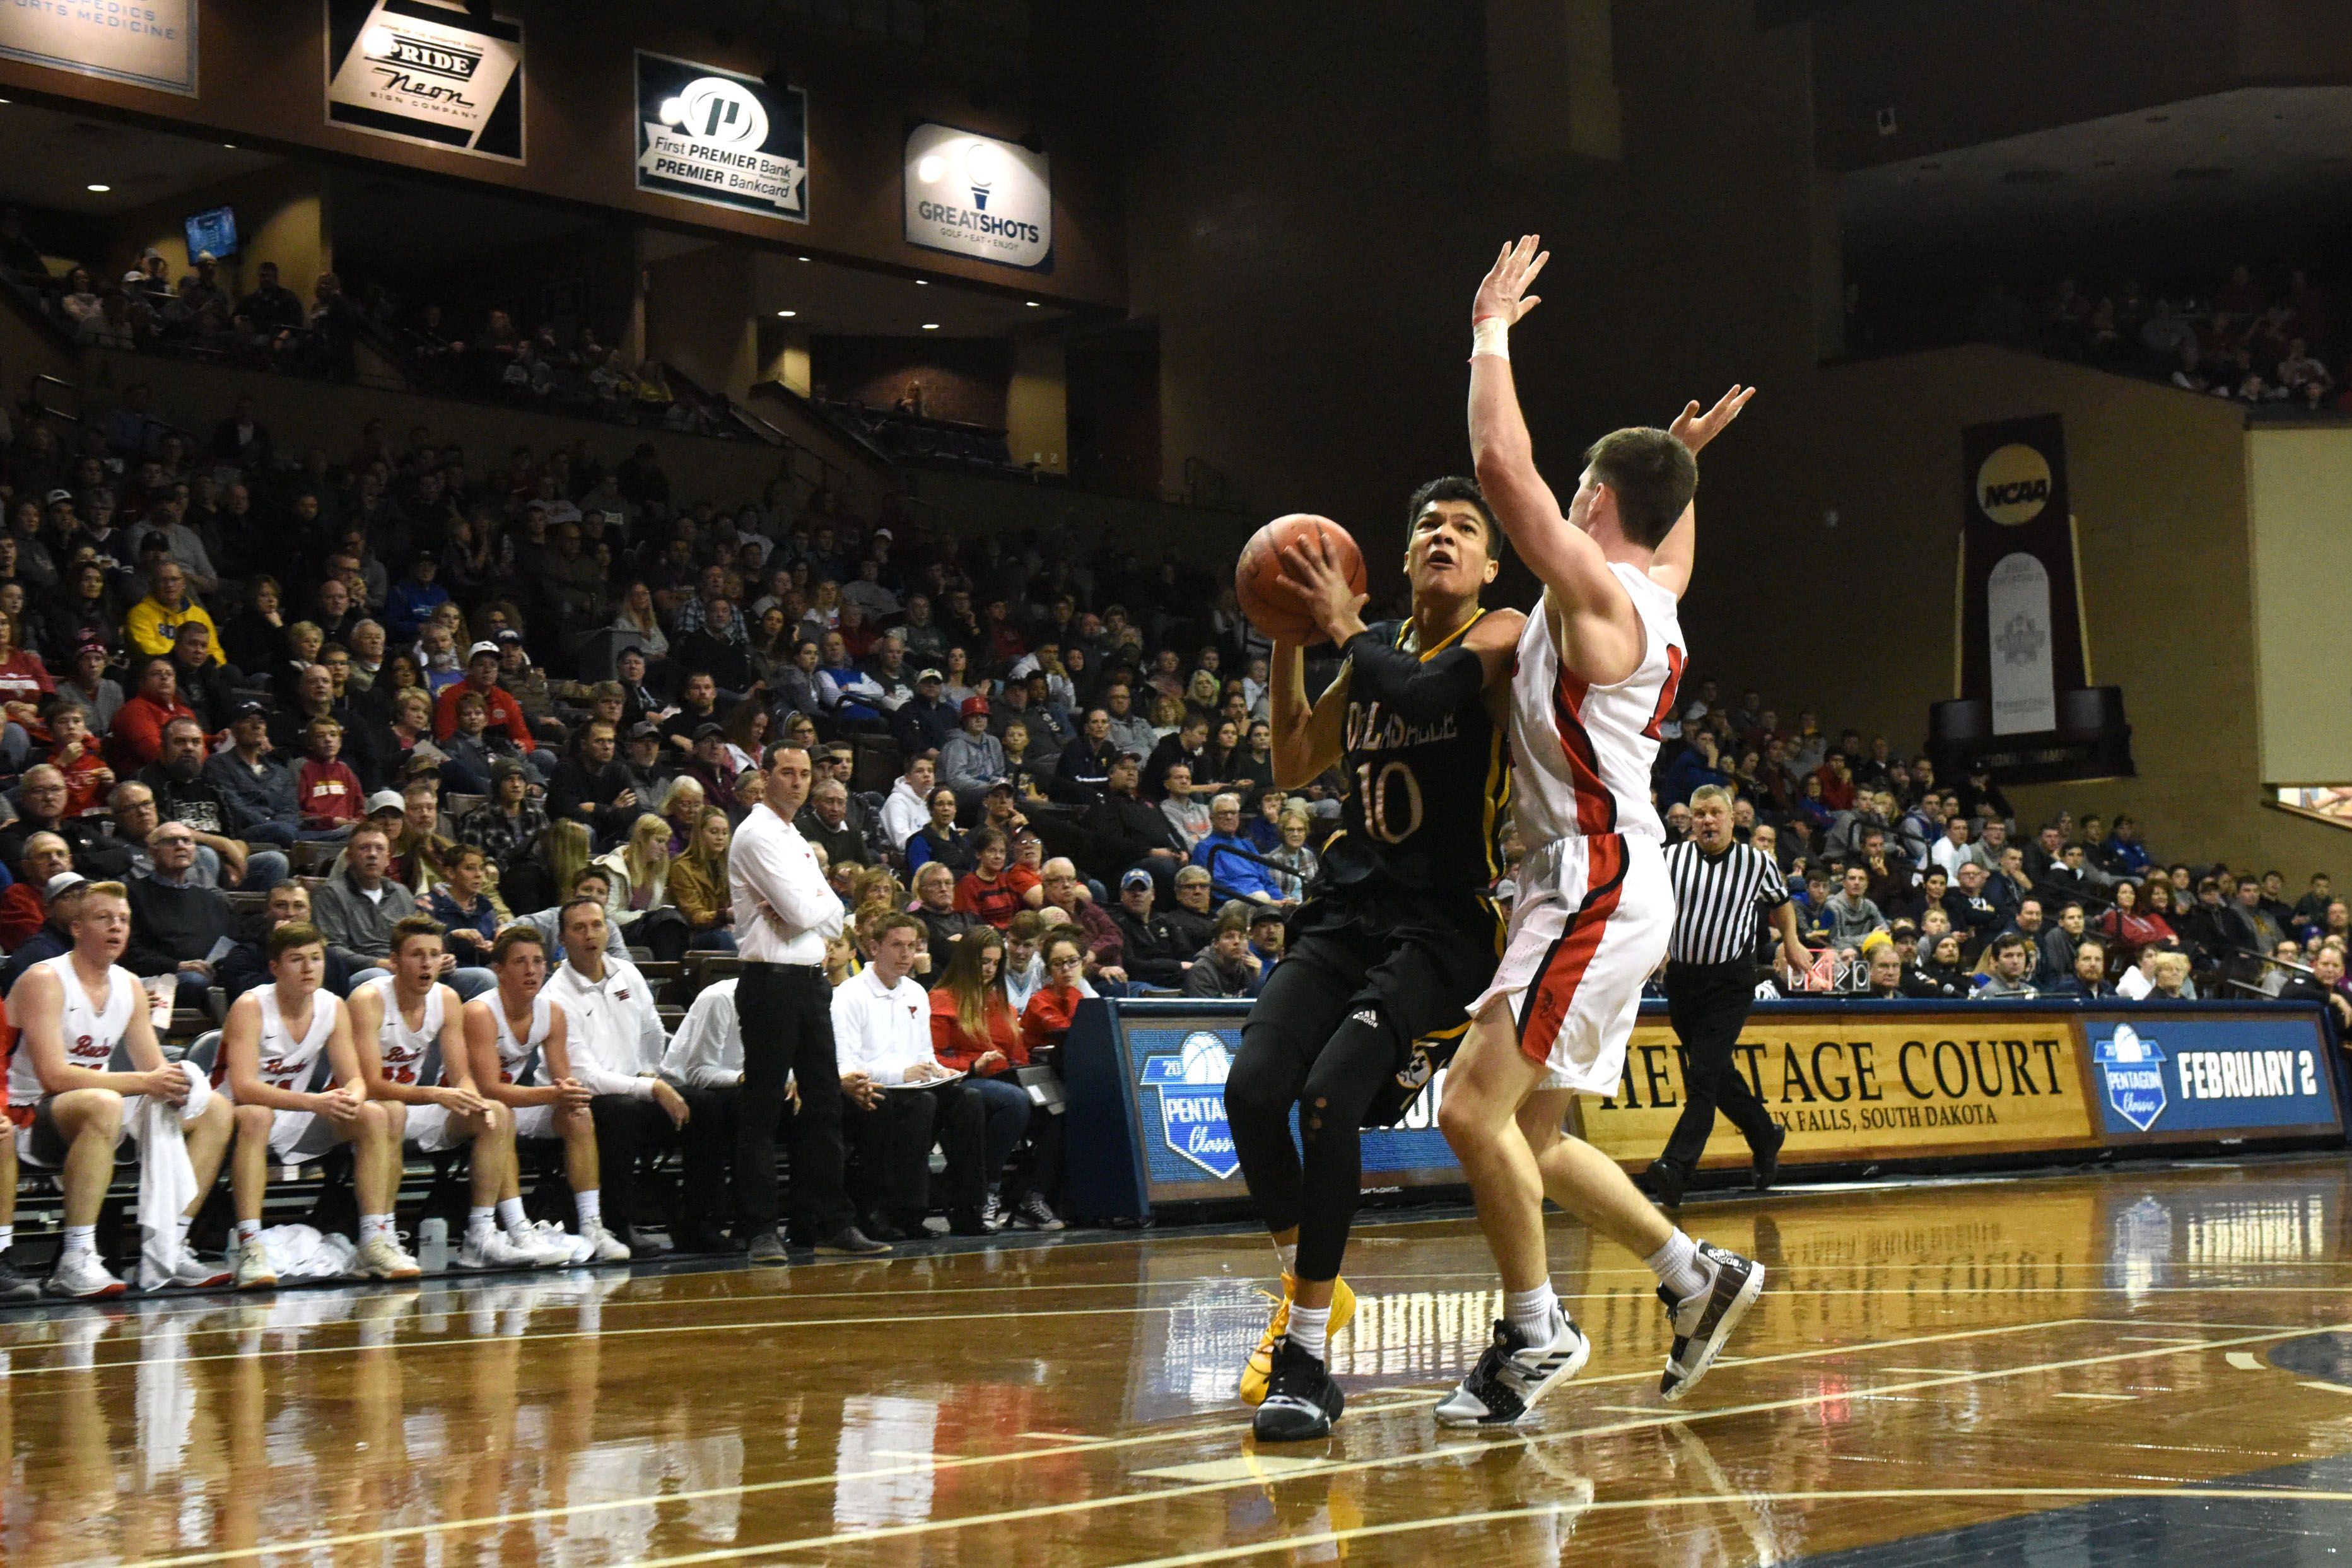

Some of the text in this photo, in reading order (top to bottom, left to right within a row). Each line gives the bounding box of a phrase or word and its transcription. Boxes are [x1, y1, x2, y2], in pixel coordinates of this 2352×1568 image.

[77, 9, 175, 40] MEDICINE
[389, 40, 471, 74] PRIDE
[372, 66, 475, 108] Neon
[370, 91, 479, 119] SIGN COMPANY
[655, 136, 792, 177] First PREMIER Bank
[655, 158, 725, 184] PREMIER
[729, 174, 790, 198] Bankcard
[940, 228, 1019, 250] GOLF EAT ENJOY
[1986, 478, 2048, 508] NCAA
[1355, 761, 1424, 845] 10
[1352, 1014, 1379, 1029] adidas
[1600, 1039, 2063, 1110] HETAGE COURT
[2108, 1070, 2162, 1091] PENTAGON
[2177, 1050, 2317, 1099] FEBRUARY 2
[1167, 1097, 1228, 1123] PENTA
[1798, 1108, 1858, 1133] FALLS,
[1861, 1106, 1922, 1130] SOUTH
[1924, 1104, 1998, 1127] DAKOTA
[1188, 1125, 1236, 1154] Class
[1707, 1249, 1740, 1267] adidas
